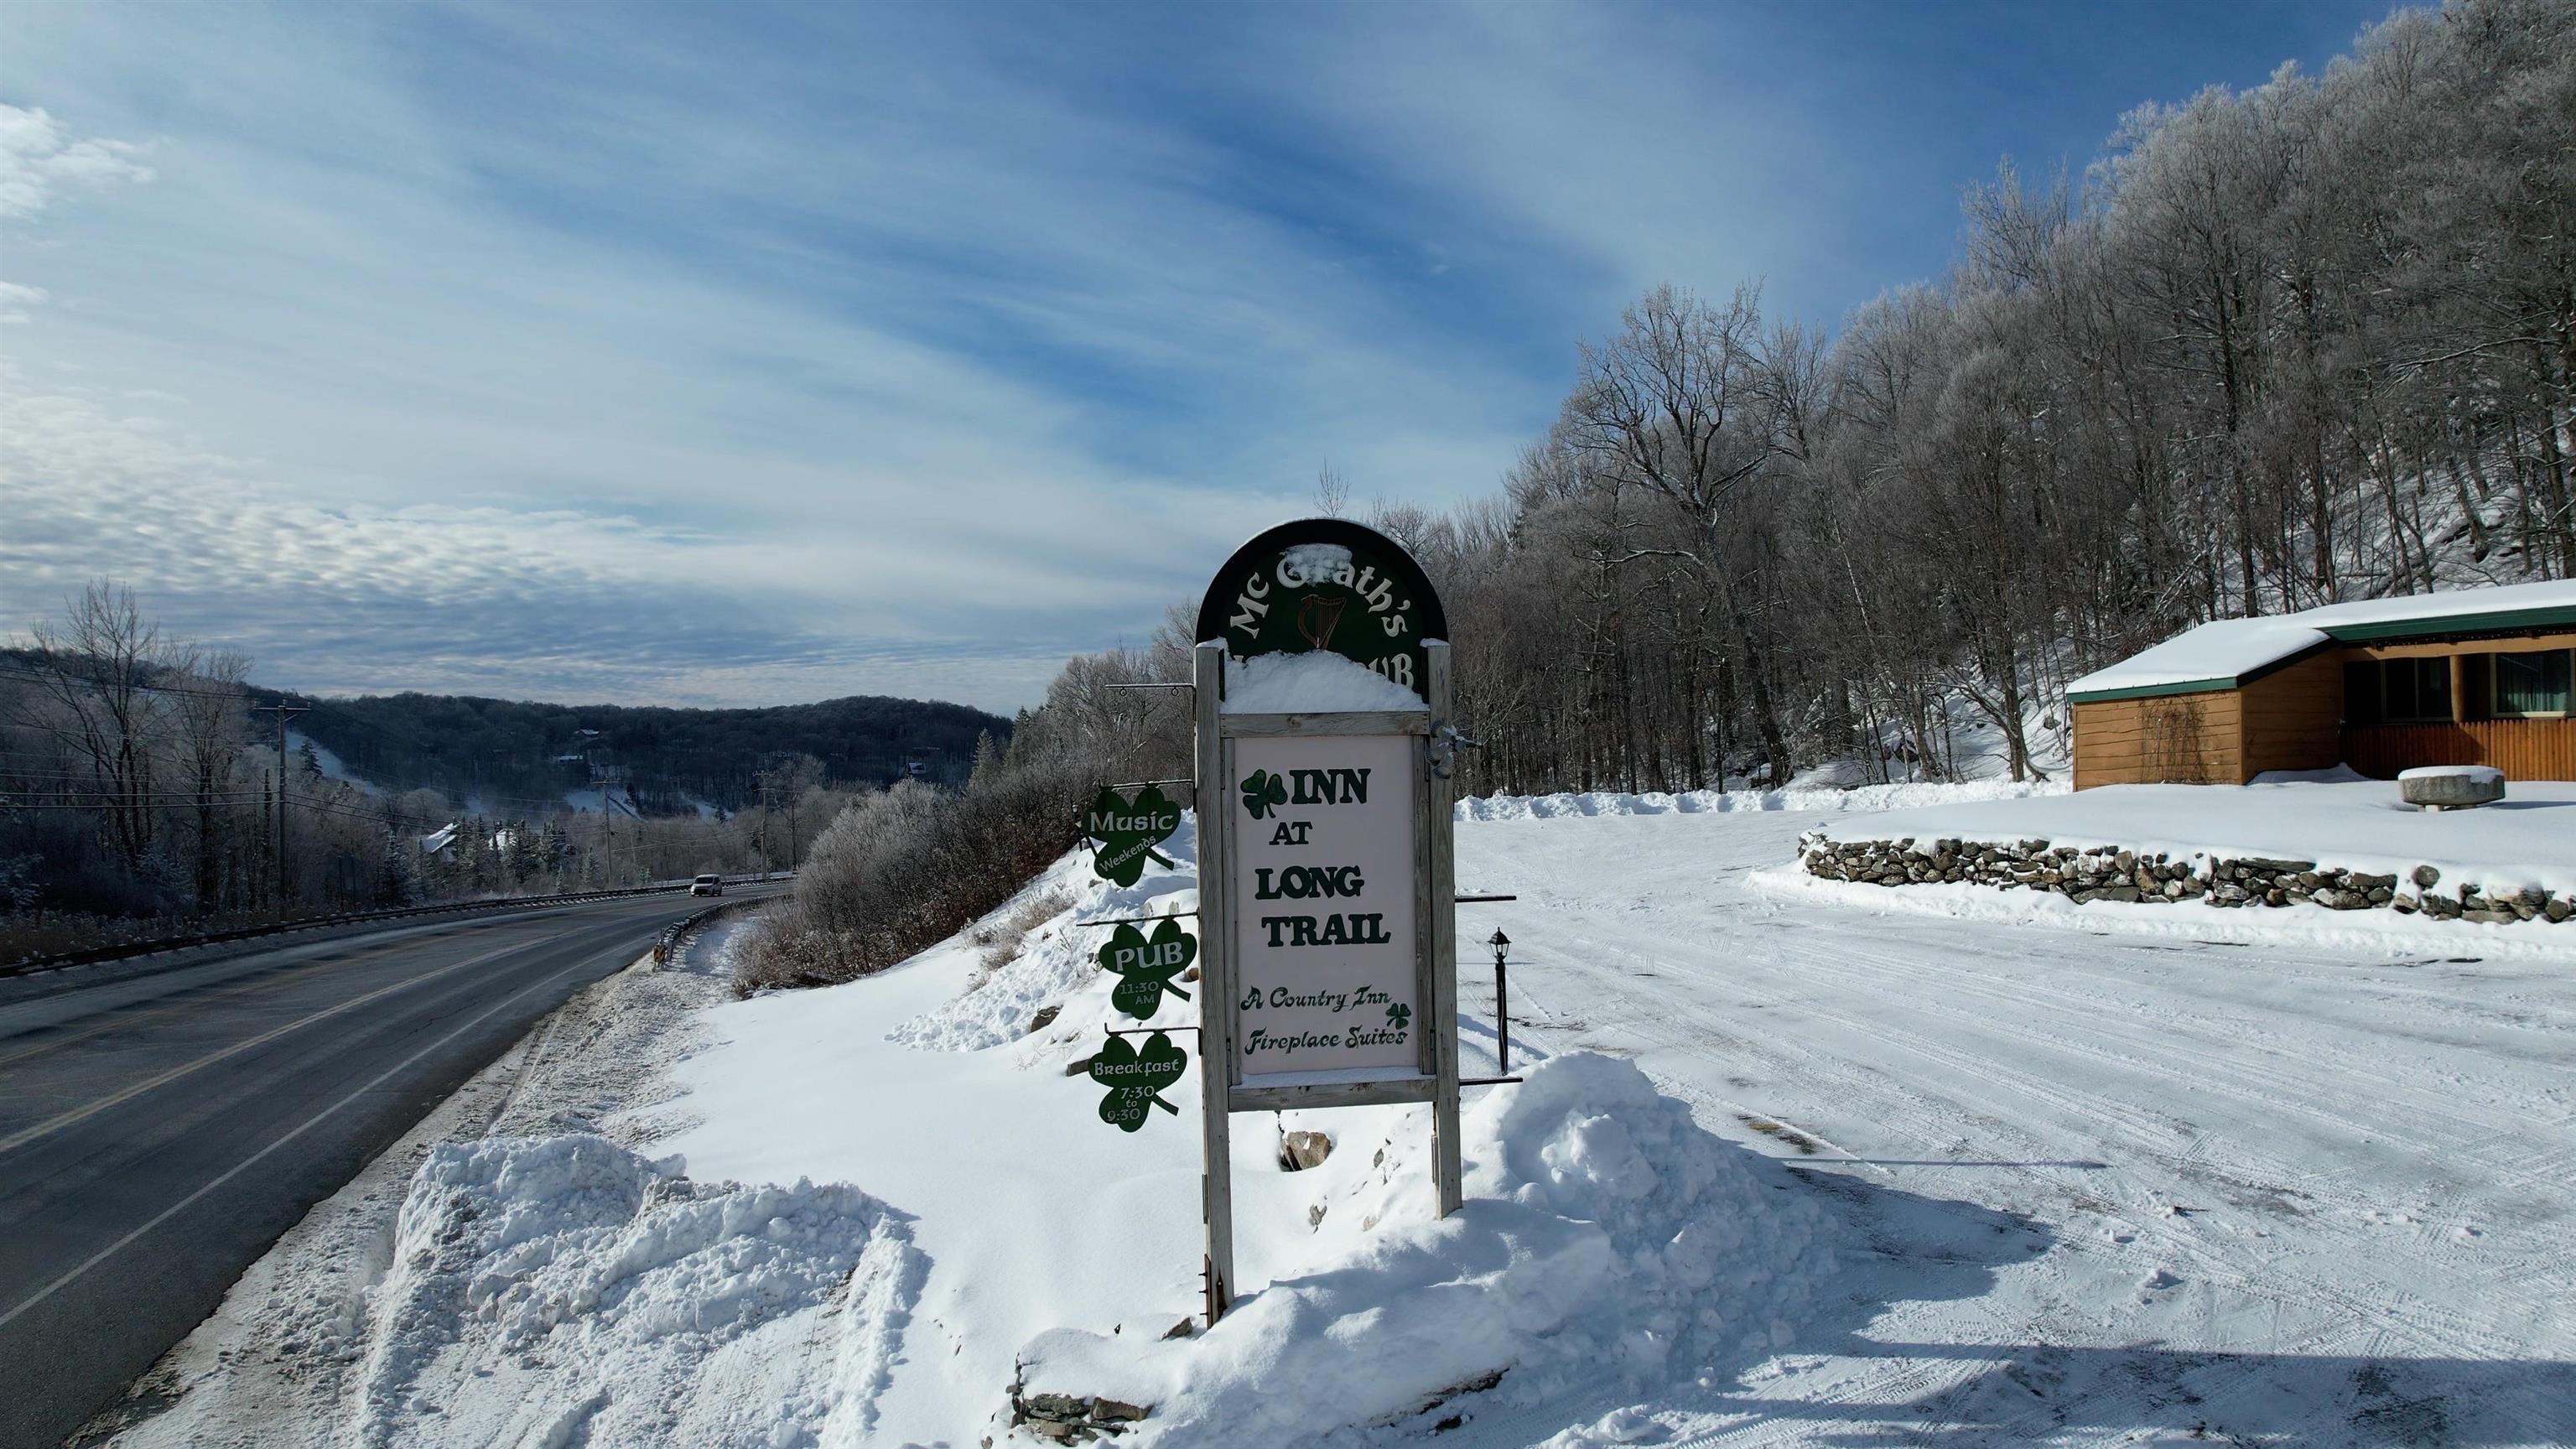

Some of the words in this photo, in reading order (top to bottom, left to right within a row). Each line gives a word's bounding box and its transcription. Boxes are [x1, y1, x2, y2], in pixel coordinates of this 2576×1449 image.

[1289, 768, 1371, 805] INN
[1090, 811, 1174, 832] Music
[1269, 821, 1313, 845] AT
[1099, 835, 1156, 872] Weekends
[1254, 865, 1365, 900] LONG
[1261, 913, 1391, 947] TRAIL
[1114, 941, 1184, 972] PUB
[1119, 980, 1159, 995] 11:30
[1135, 994, 1155, 1005] AM
[1240, 985, 1265, 1010] A
[1270, 986, 1348, 1012] Country
[1349, 984, 1393, 1010] Inn
[1244, 1026, 1342, 1055] Fireplace
[1344, 1024, 1409, 1048] Suites
[1094, 1058, 1180, 1077] Breakfast
[1120, 1085, 1155, 1099] 7:30
[1125, 1099, 1138, 1108] to
[1107, 1108, 1140, 1122] 9:30
